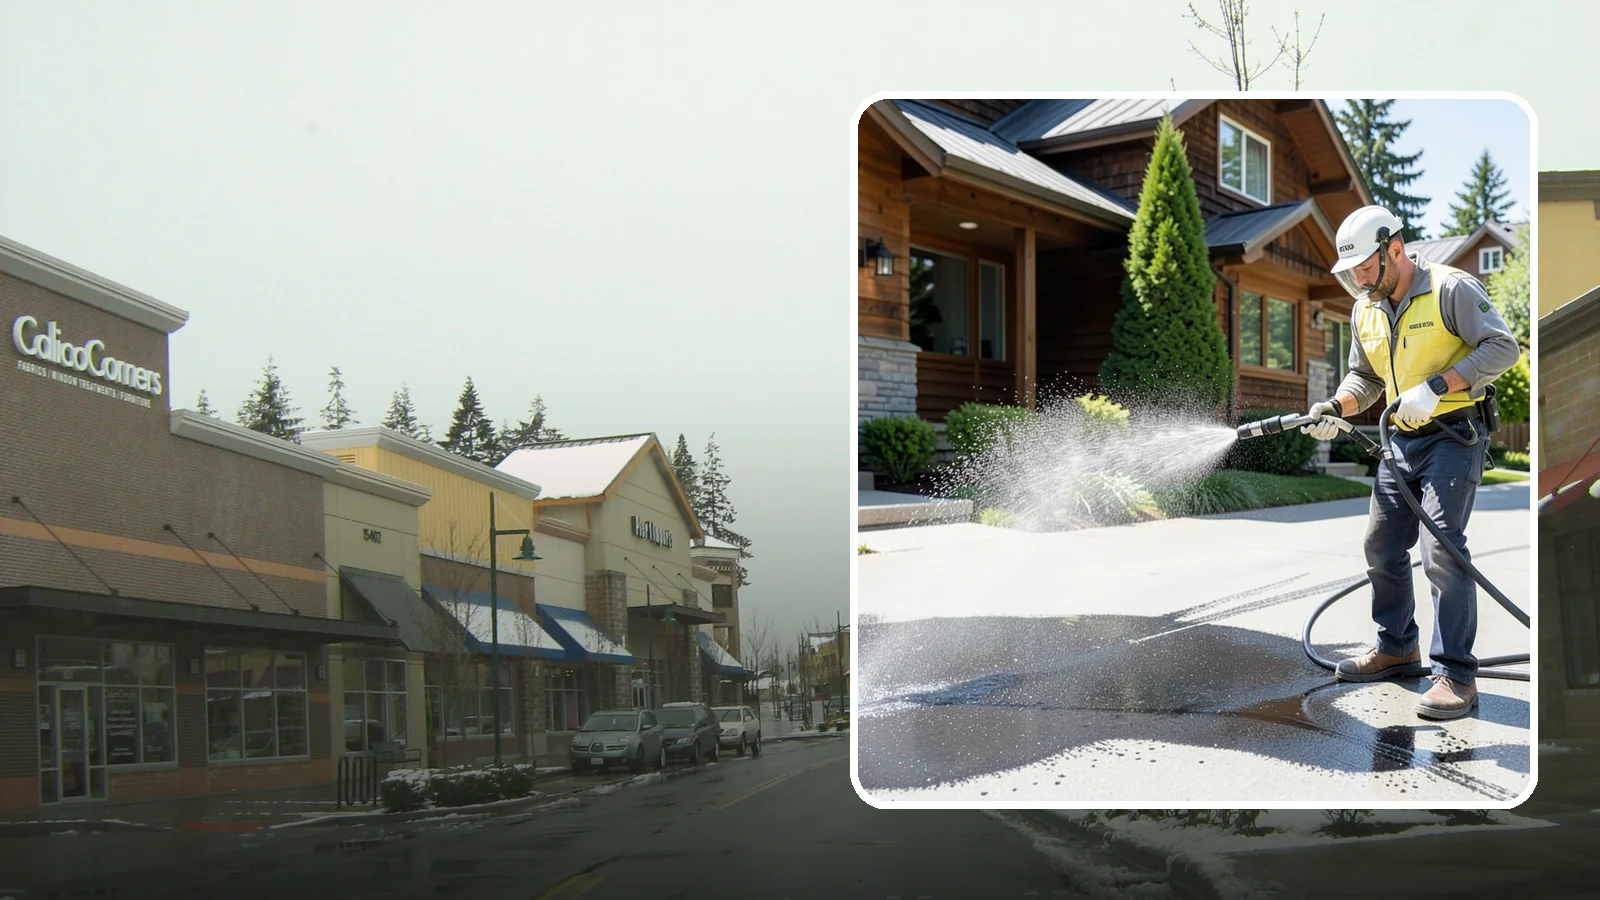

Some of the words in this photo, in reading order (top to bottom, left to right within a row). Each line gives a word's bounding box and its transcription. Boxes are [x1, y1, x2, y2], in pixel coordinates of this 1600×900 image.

[17, 360, 47, 378] FABRICS
[51, 370, 78, 387] WINDOW
[79, 378, 117, 398] TREATMENTS
[120, 390, 151, 409] FURNITURE
